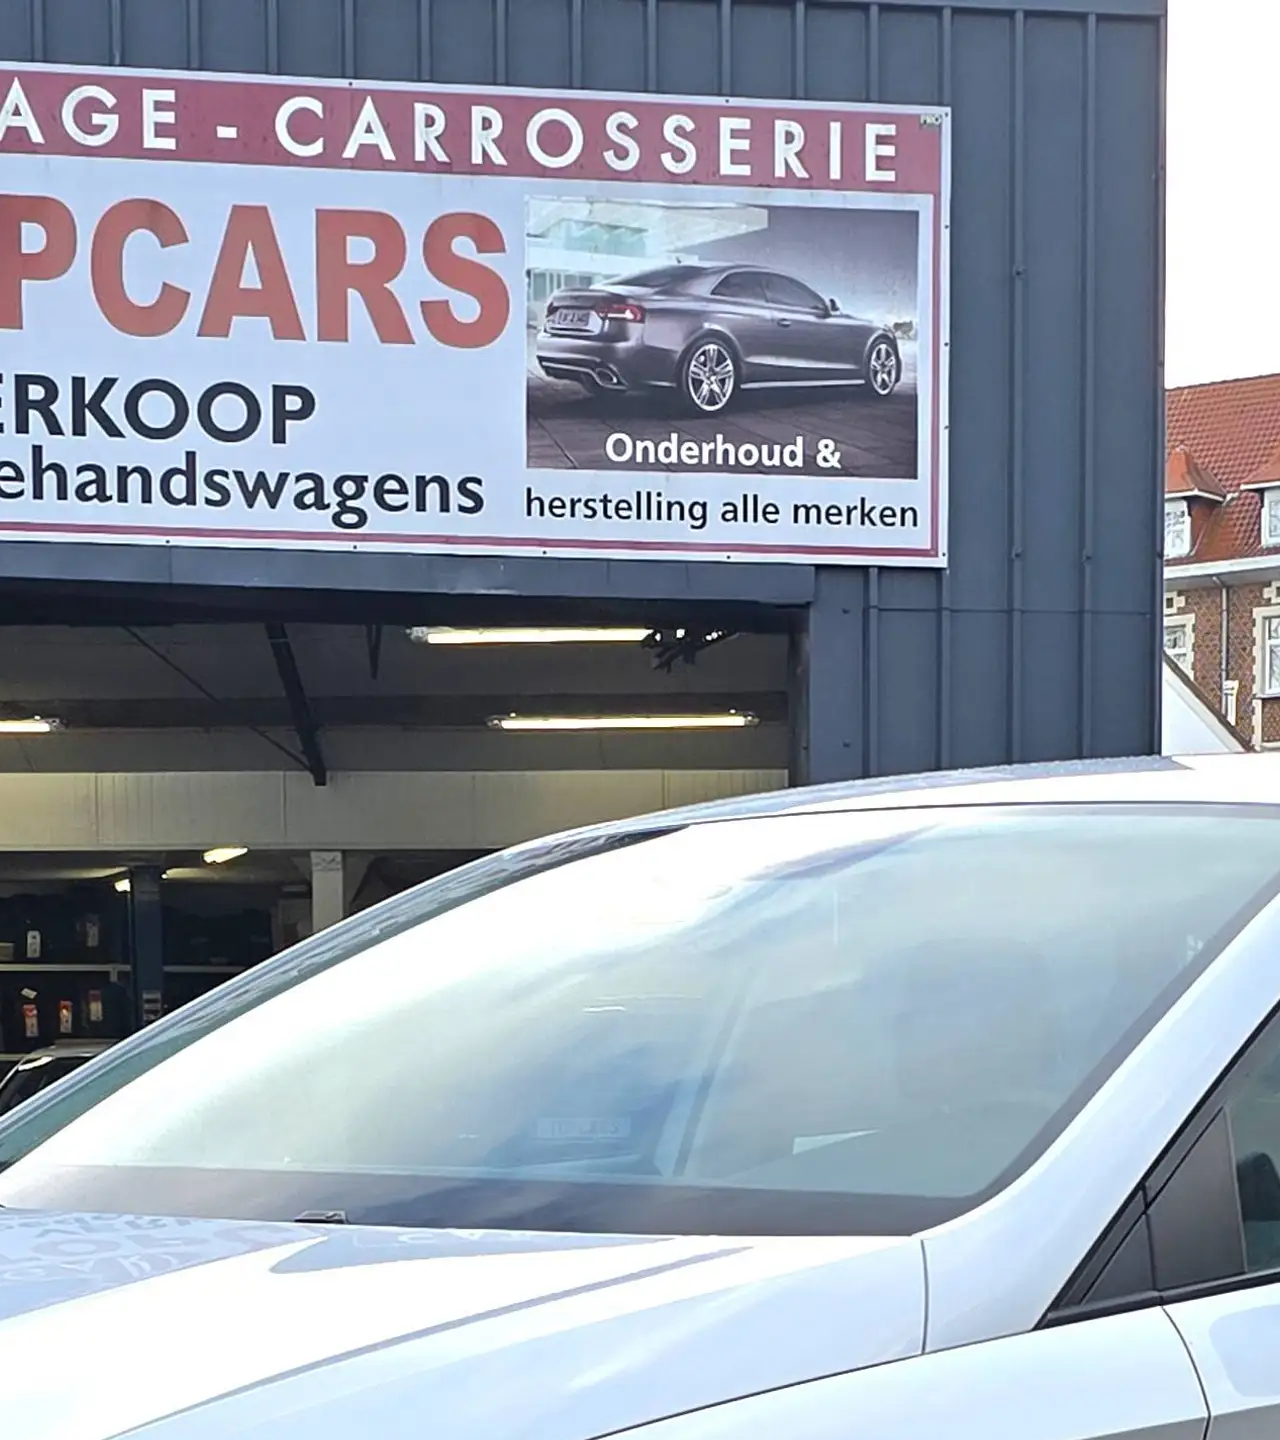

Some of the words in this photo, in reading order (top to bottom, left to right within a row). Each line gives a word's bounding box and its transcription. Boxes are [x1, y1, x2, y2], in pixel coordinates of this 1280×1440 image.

[216, 124, 238, 139] -
[274, 94, 897, 183] CARROSSERIE
[605, 431, 805, 467] Onderhoud
[815, 438, 842, 469] &
[524, 487, 709, 530] herstelling
[720, 493, 780, 525] alle
[792, 496, 919, 529] merken
